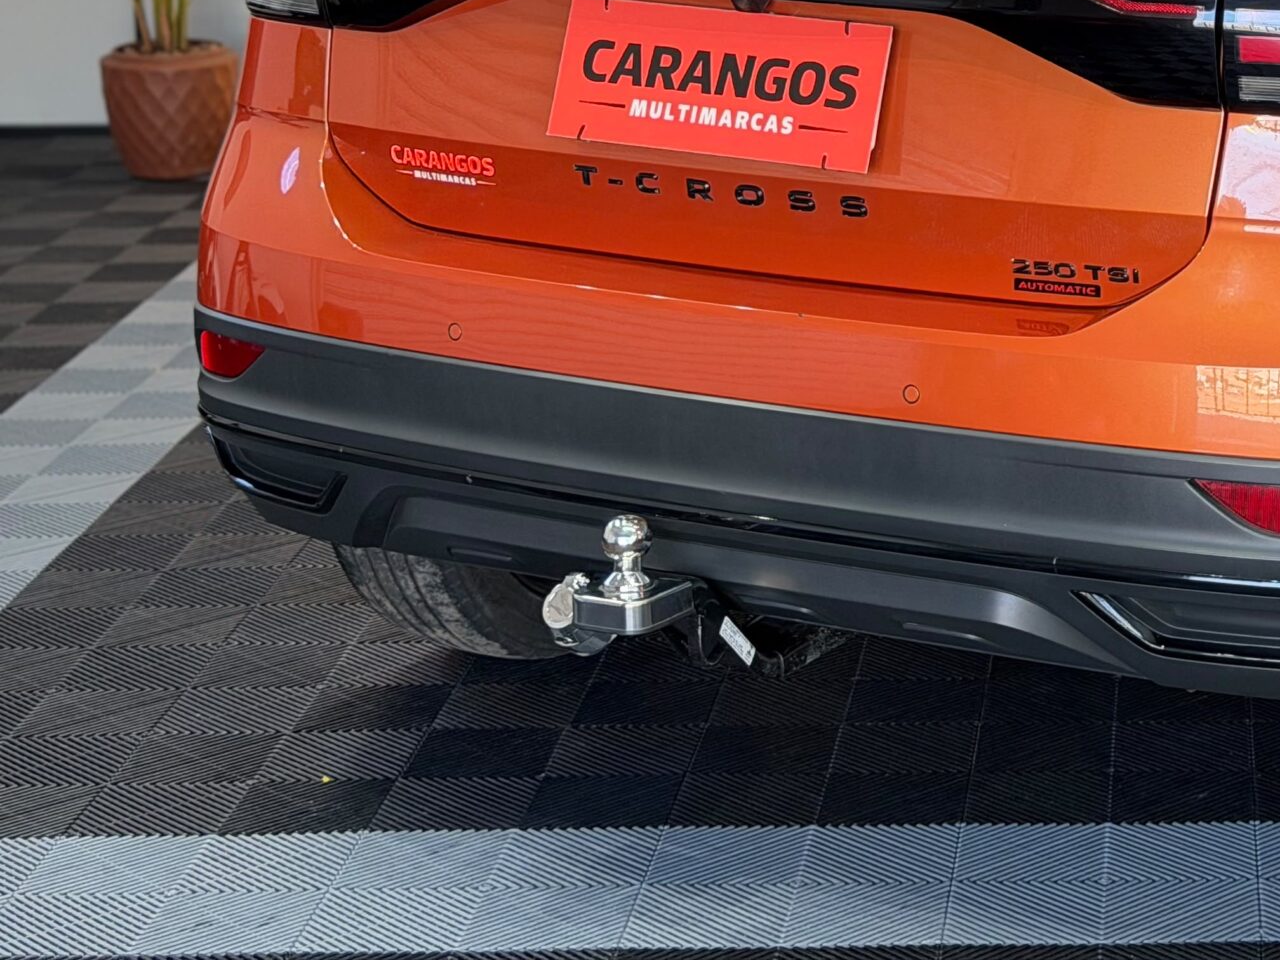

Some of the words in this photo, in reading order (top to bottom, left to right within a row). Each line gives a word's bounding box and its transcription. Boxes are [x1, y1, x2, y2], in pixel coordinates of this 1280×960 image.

[582, 39, 860, 109] CARANGOS
[628, 99, 794, 135] MULTIMARCAS
[390, 145, 495, 177] CARANGOS
[413, 169, 477, 186] MULTIMARCAS
[1011, 258, 1077, 279] 250
[1084, 264, 1140, 283] TSI
[1017, 280, 1097, 296] AUTOMATIC
